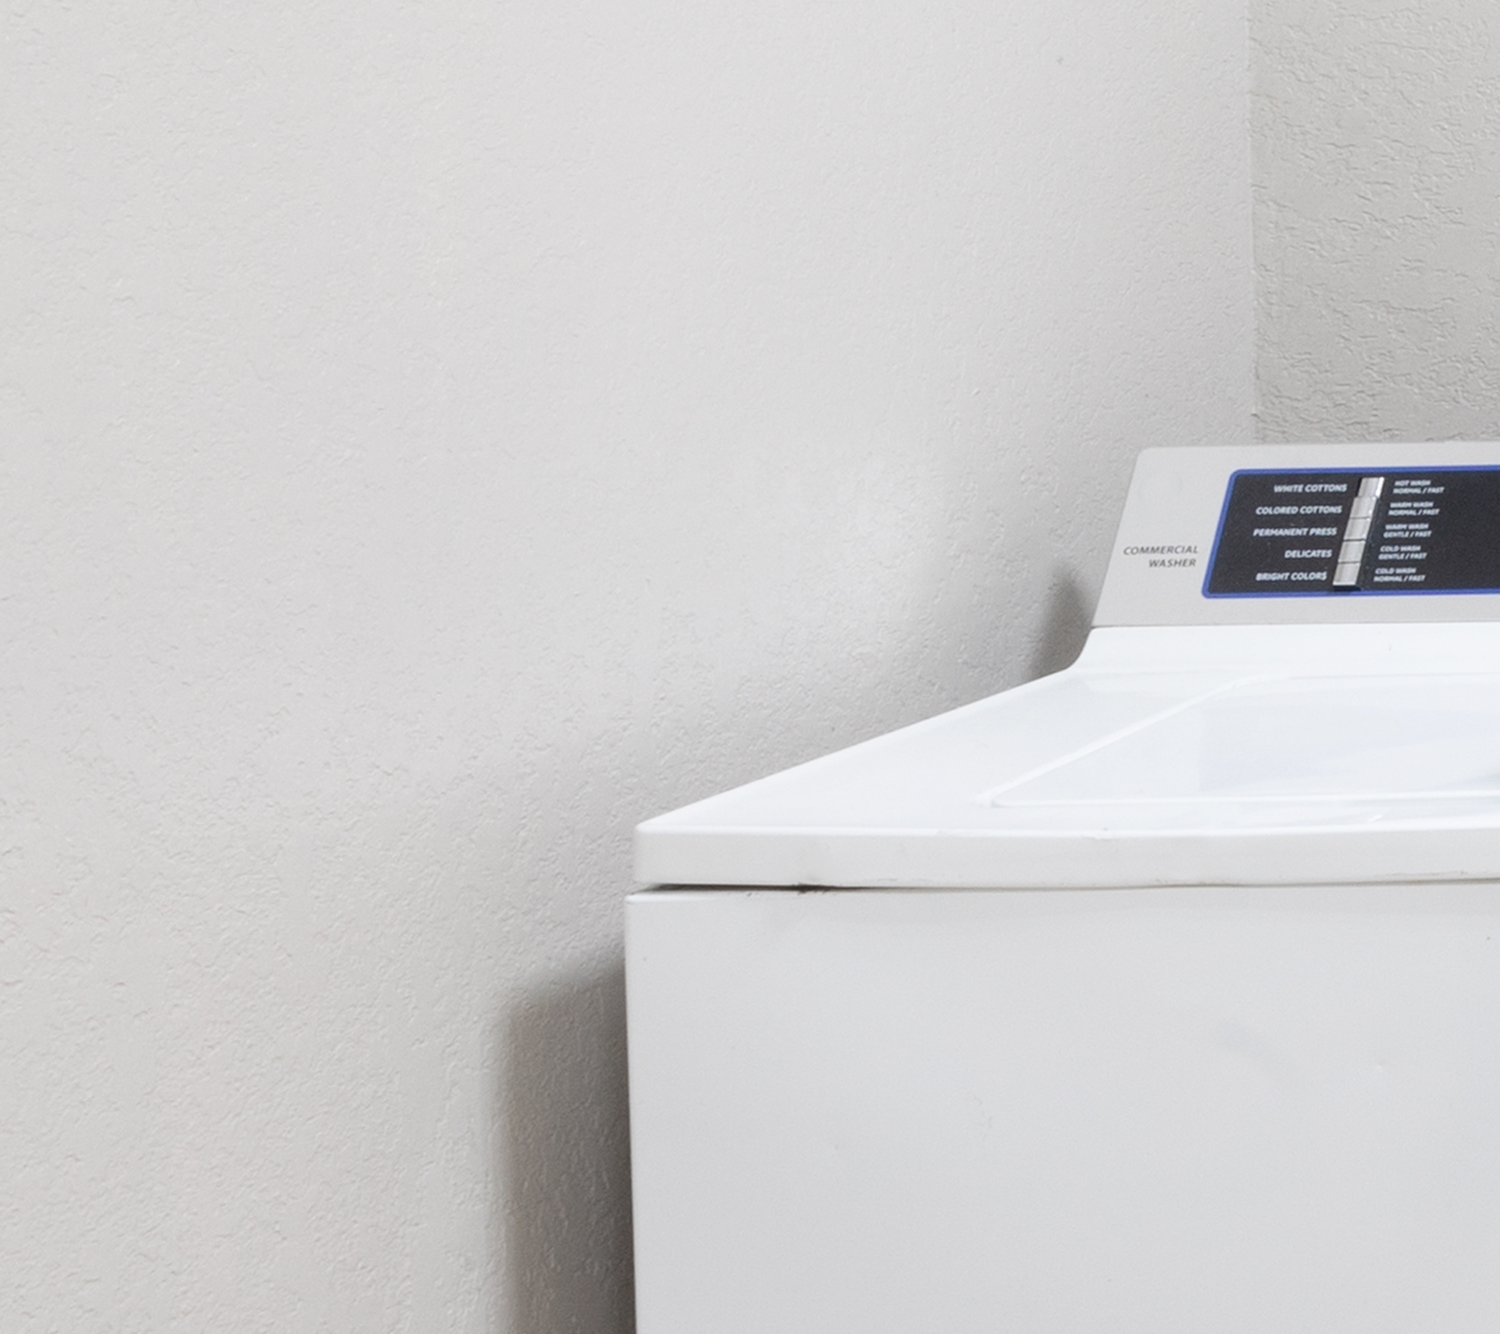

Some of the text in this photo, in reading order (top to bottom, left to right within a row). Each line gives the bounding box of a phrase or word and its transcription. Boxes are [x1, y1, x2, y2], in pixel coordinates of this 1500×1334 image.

[1274, 483, 1348, 493] WHITE COTTONS
[1255, 505, 1343, 515] COLORED COTTONS
[1253, 527, 1338, 537] PERMANENT PRESS
[1123, 545, 1198, 555] COMMERCIAL
[1284, 550, 1332, 558] DELICATES
[1149, 559, 1196, 568] WASHER
[1255, 572, 1327, 581] BRIGHT COLORS
